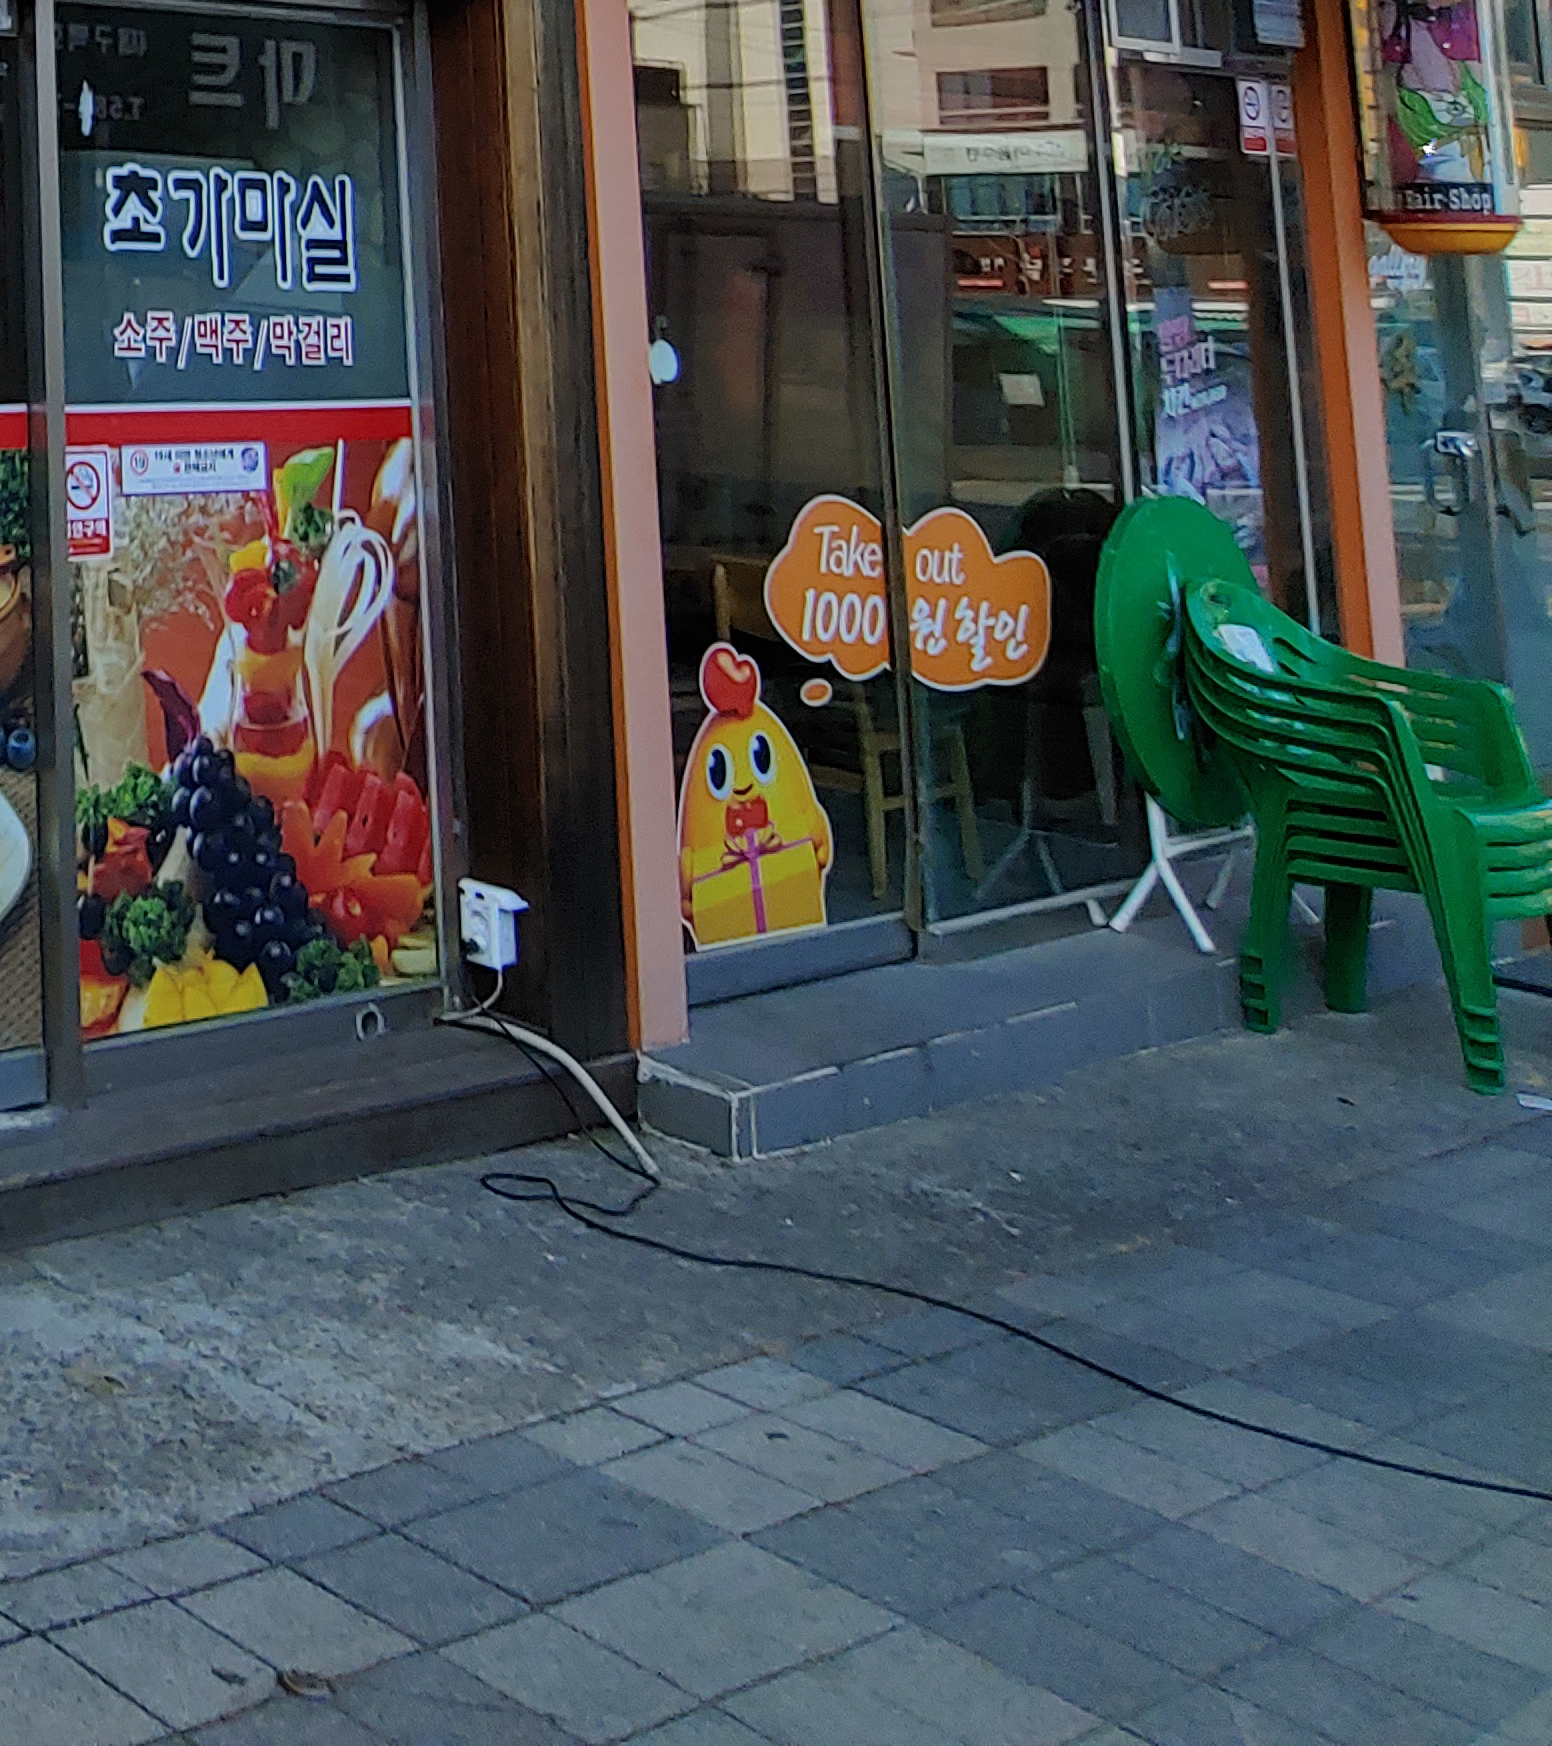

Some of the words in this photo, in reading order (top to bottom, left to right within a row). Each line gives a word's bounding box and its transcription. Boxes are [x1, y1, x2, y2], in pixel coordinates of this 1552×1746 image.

[104, 163, 359, 292] 초가마실
[113, 309, 355, 371] 소주/맥주/막걸리
[813, 524, 883, 579] Take
[915, 542, 967, 586] out
[954, 595, 1030, 673] 할인
